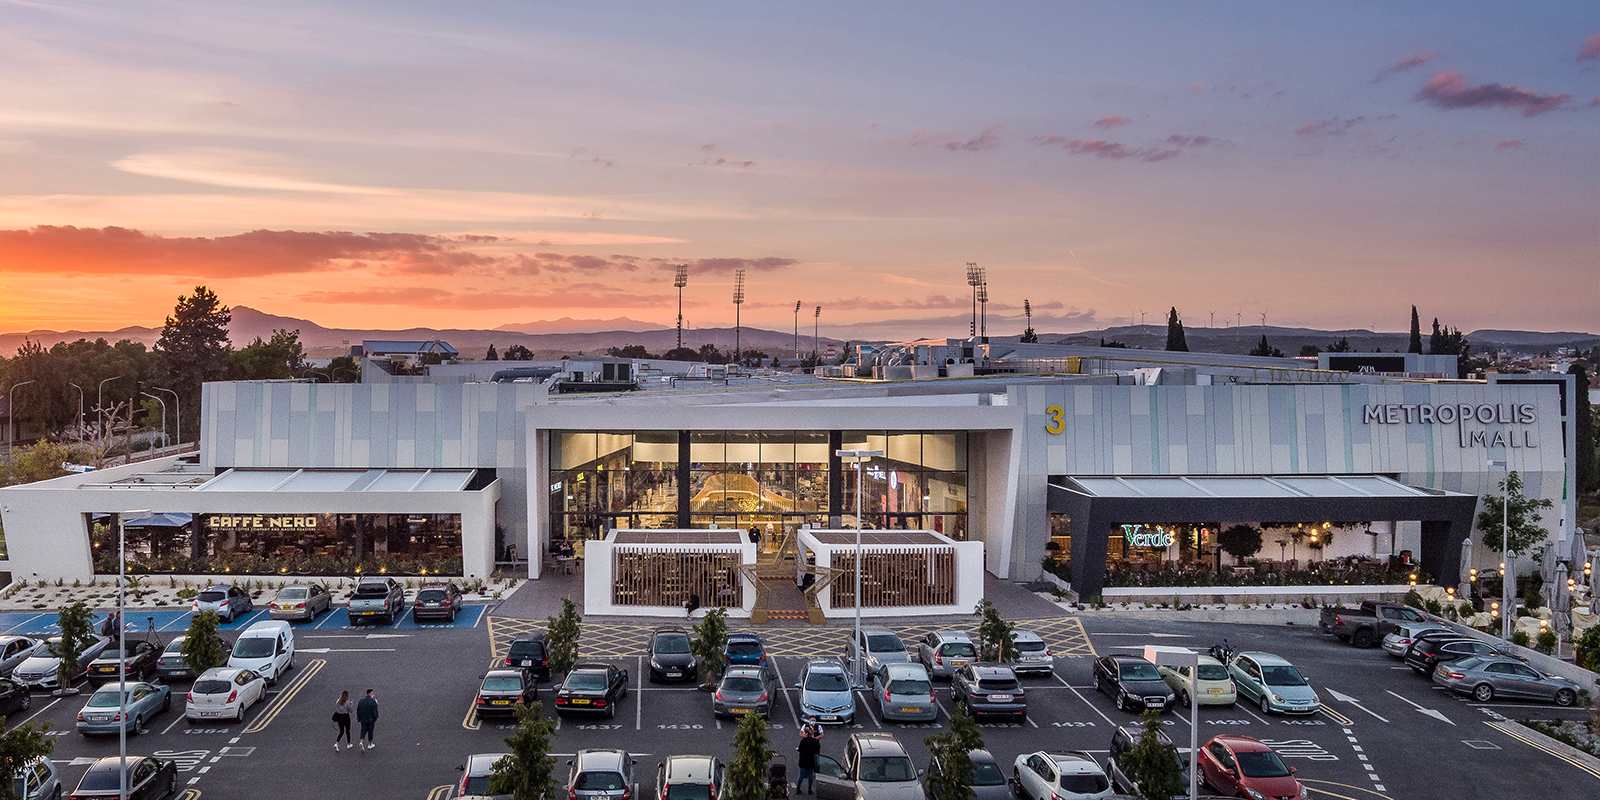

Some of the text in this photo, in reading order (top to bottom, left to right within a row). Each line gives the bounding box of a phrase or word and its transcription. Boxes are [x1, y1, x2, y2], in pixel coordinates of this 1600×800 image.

[1358, 365, 1376, 373] ZARA
[1045, 405, 1066, 435] 3
[1363, 403, 1537, 448] METROPOLIS
[1470, 430, 1538, 448] MALL
[269, 517, 317, 528] NERO
[1121, 524, 1173, 547] Verde
